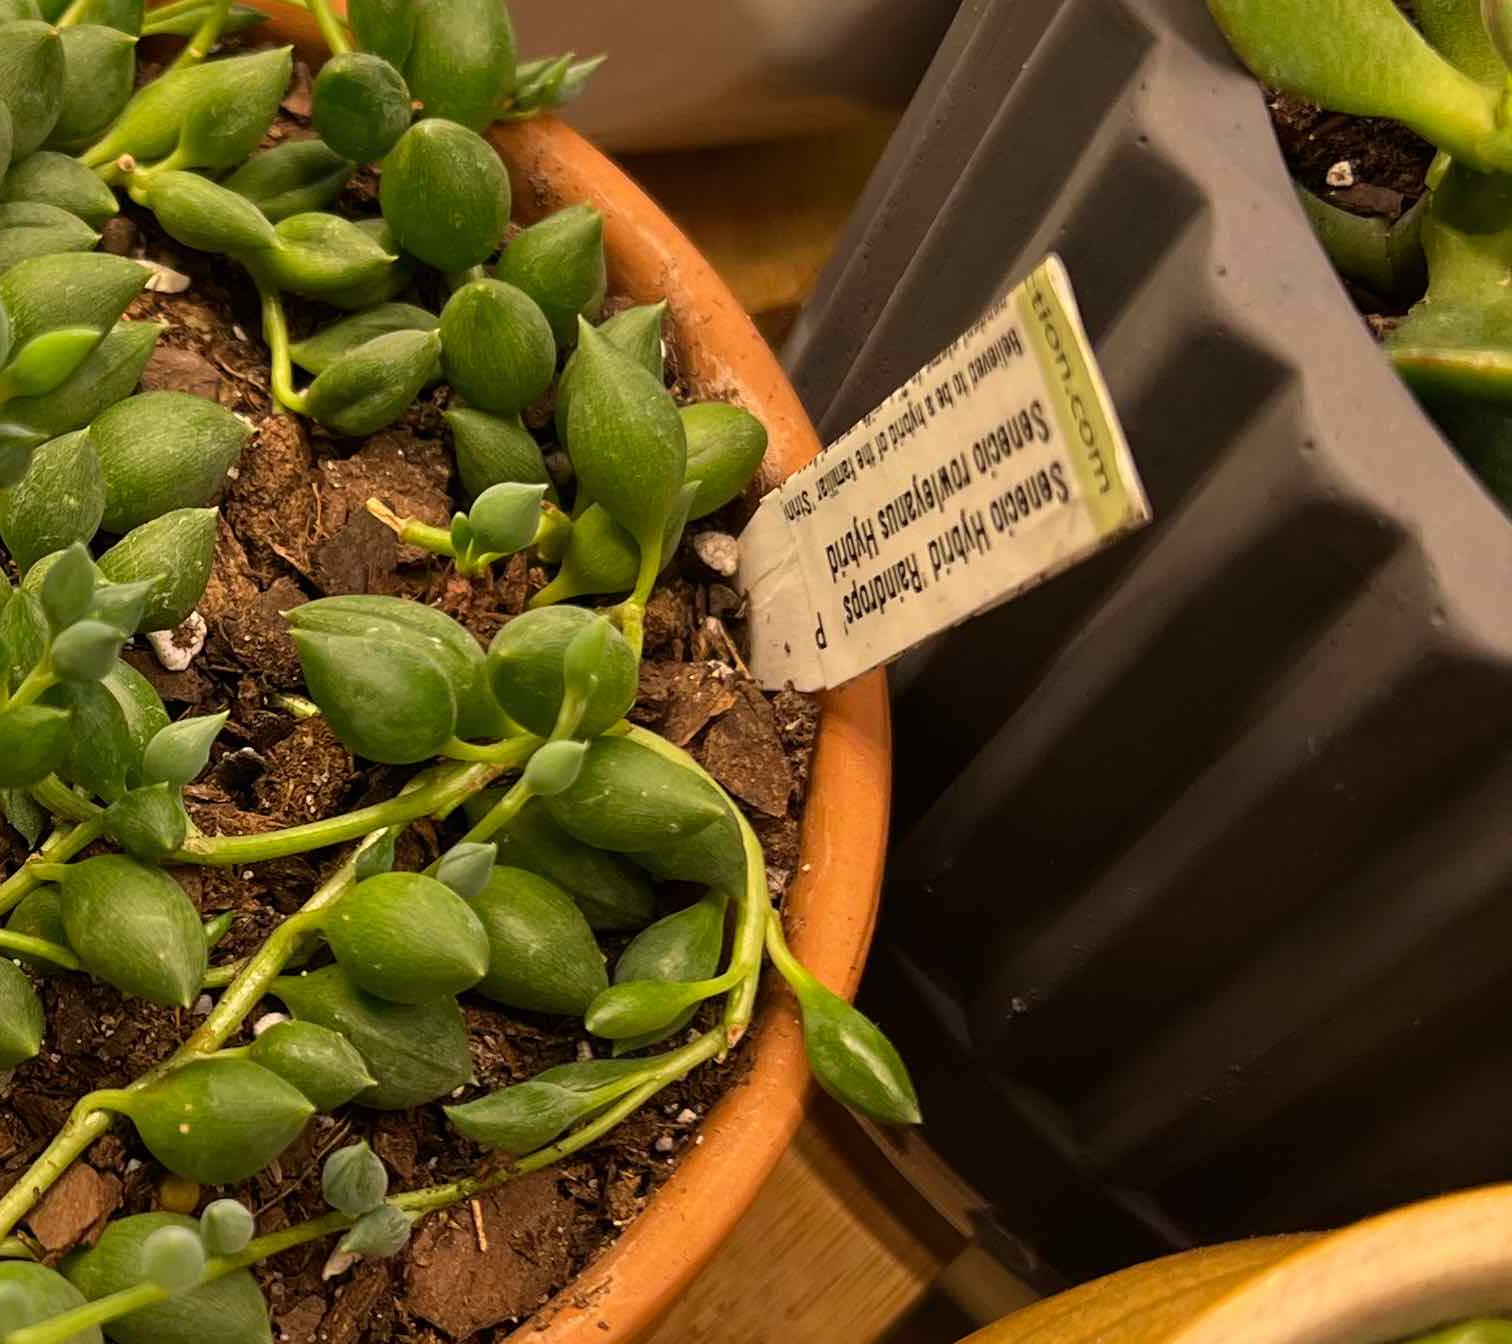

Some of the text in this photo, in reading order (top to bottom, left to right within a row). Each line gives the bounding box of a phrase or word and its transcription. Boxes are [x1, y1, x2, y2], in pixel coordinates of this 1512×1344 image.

[968, 328, 1023, 390] Believed
[935, 382, 954, 409] be
[952, 371, 969, 399] to
[924, 394, 937, 417] a
[888, 401, 928, 452] hybrid
[855, 443, 876, 470] the
[875, 431, 889, 462] of
[815, 456, 857, 501] familiar
[825, 400, 1050, 583] Senecio rowleyanus Hybrid
[815, 460, 1069, 650] Senecio Hybrid 'Raindrops' P
